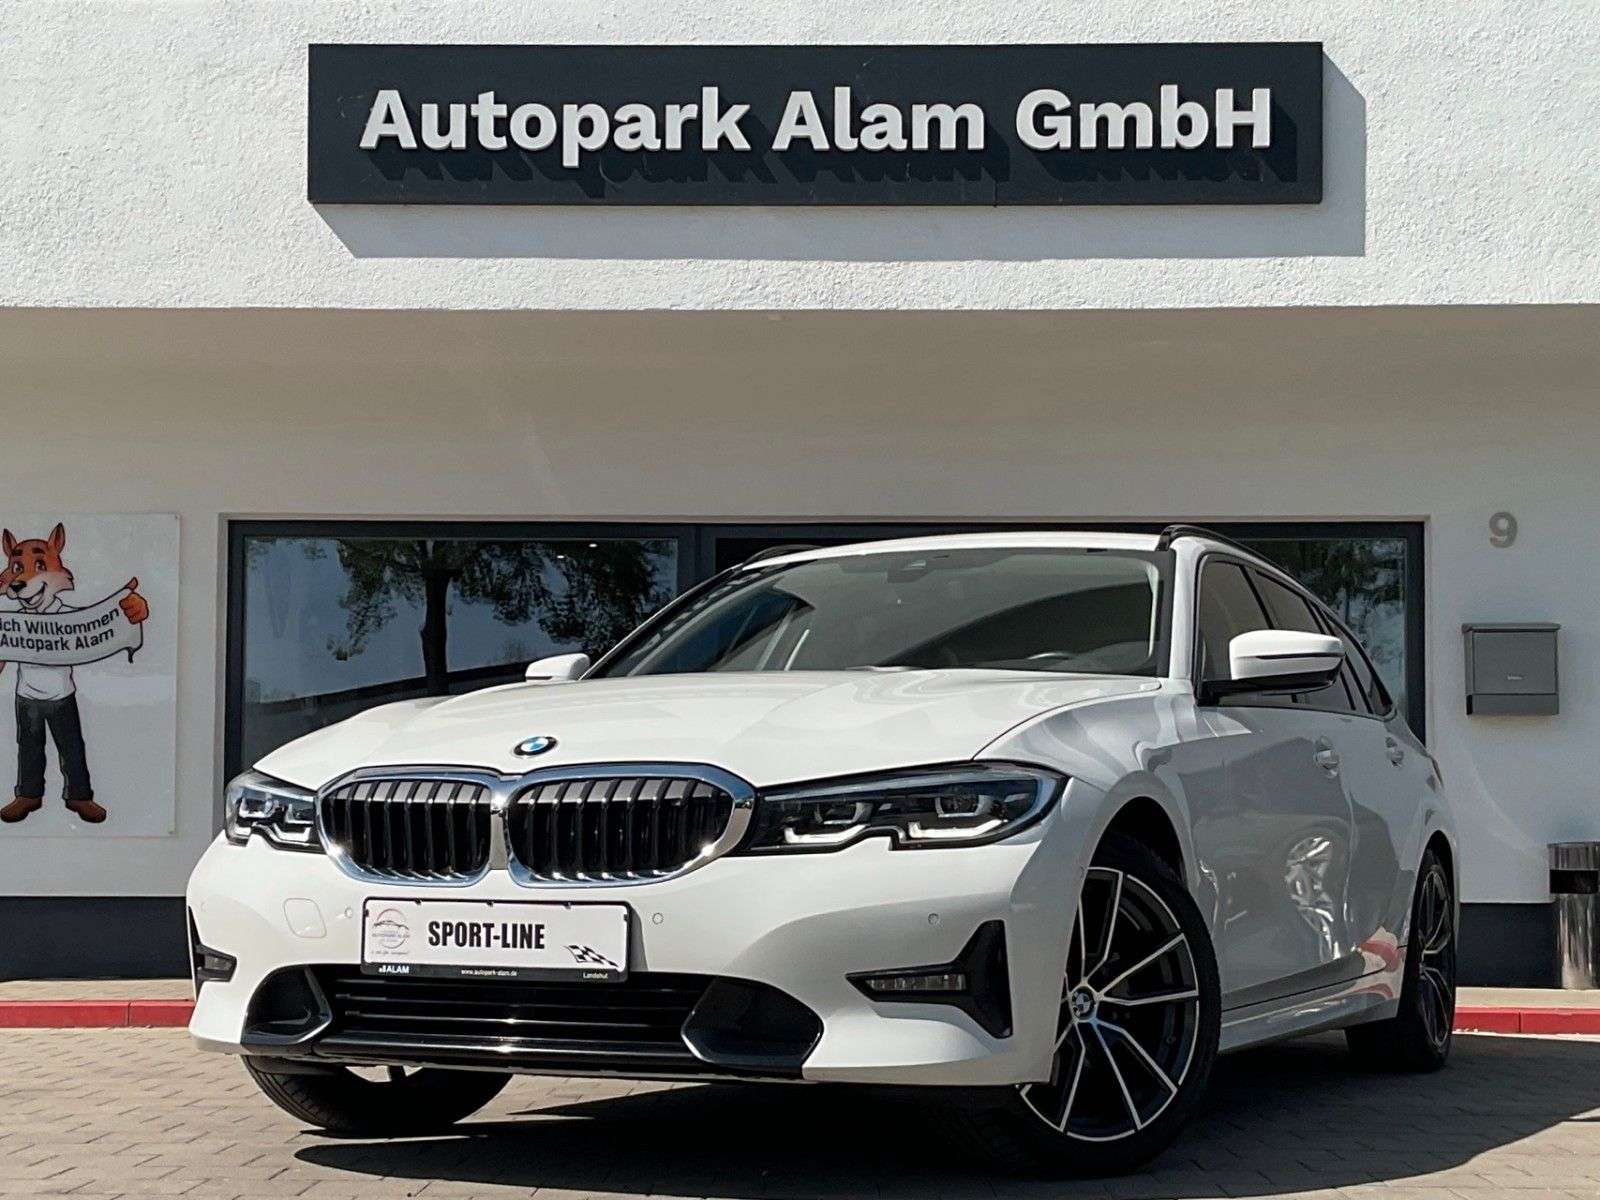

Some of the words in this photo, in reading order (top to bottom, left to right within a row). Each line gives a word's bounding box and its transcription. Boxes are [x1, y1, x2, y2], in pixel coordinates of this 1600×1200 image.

[359, 86, 751, 168] Autopark
[771, 86, 985, 151] Alam
[1015, 84, 1272, 150] GmbH
[1488, 511, 1518, 548] 9
[24, 607, 120, 636] Willkommen
[0, 633, 71, 652] Autopark
[75, 628, 115, 650] Alam
[428, 920, 546, 949] SPORT-LINE
